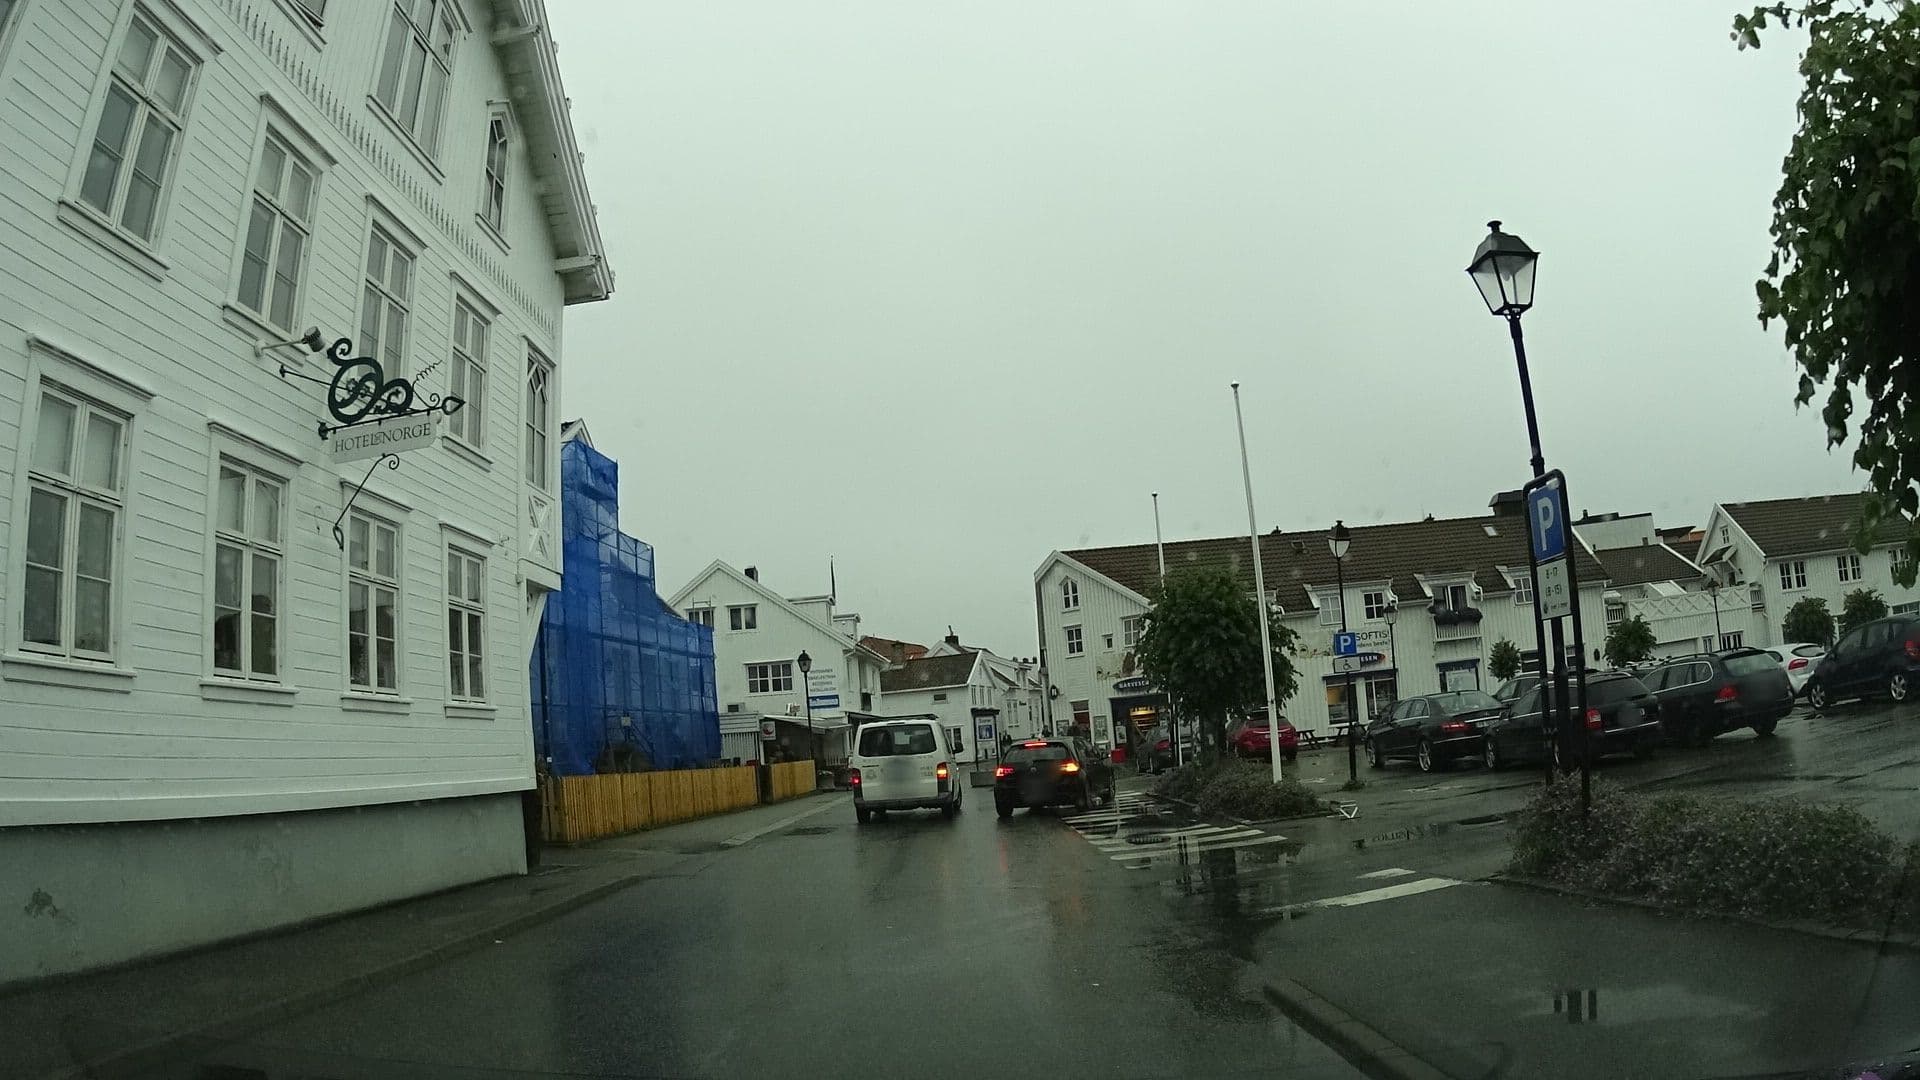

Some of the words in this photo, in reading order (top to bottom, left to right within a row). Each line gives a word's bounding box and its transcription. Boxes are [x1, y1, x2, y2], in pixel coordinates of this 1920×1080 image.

[335, 432, 381, 453] HOTEL
[378, 423, 431, 444] NORGE
[1536, 496, 1554, 552] P
[1340, 635, 1352, 653] P
